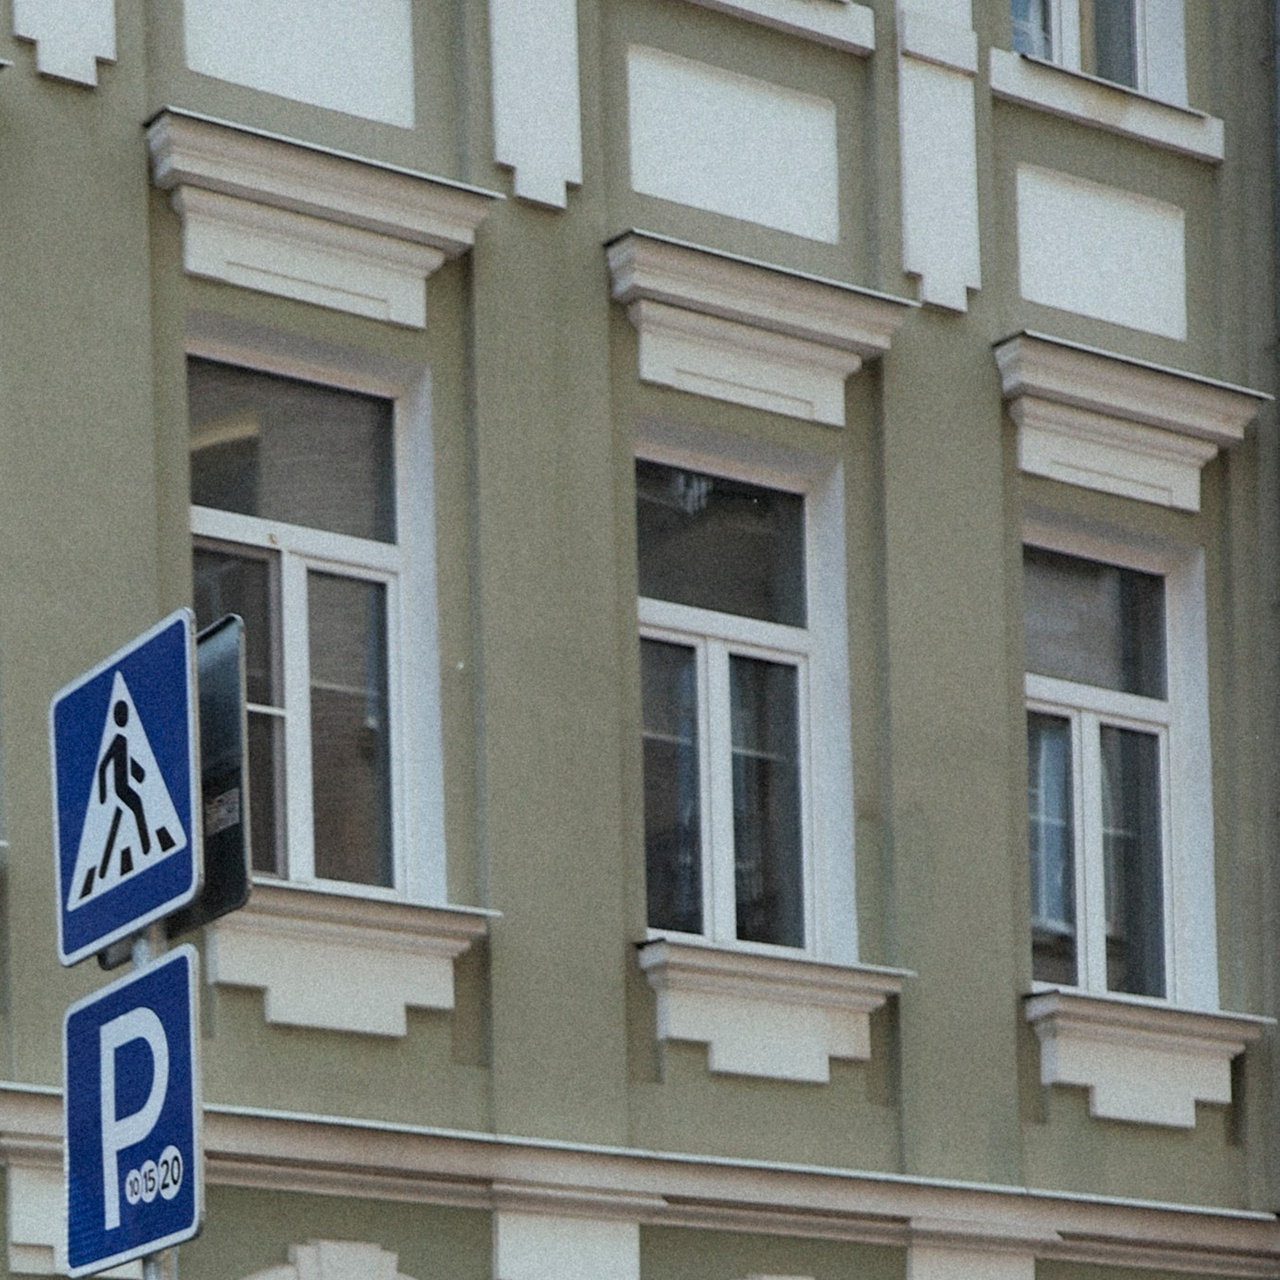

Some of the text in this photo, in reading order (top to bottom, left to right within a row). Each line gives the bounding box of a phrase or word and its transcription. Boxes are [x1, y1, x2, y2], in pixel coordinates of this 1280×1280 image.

[100, 1006, 169, 1230] P
[129, 1155, 181, 1197] 10 15 20
